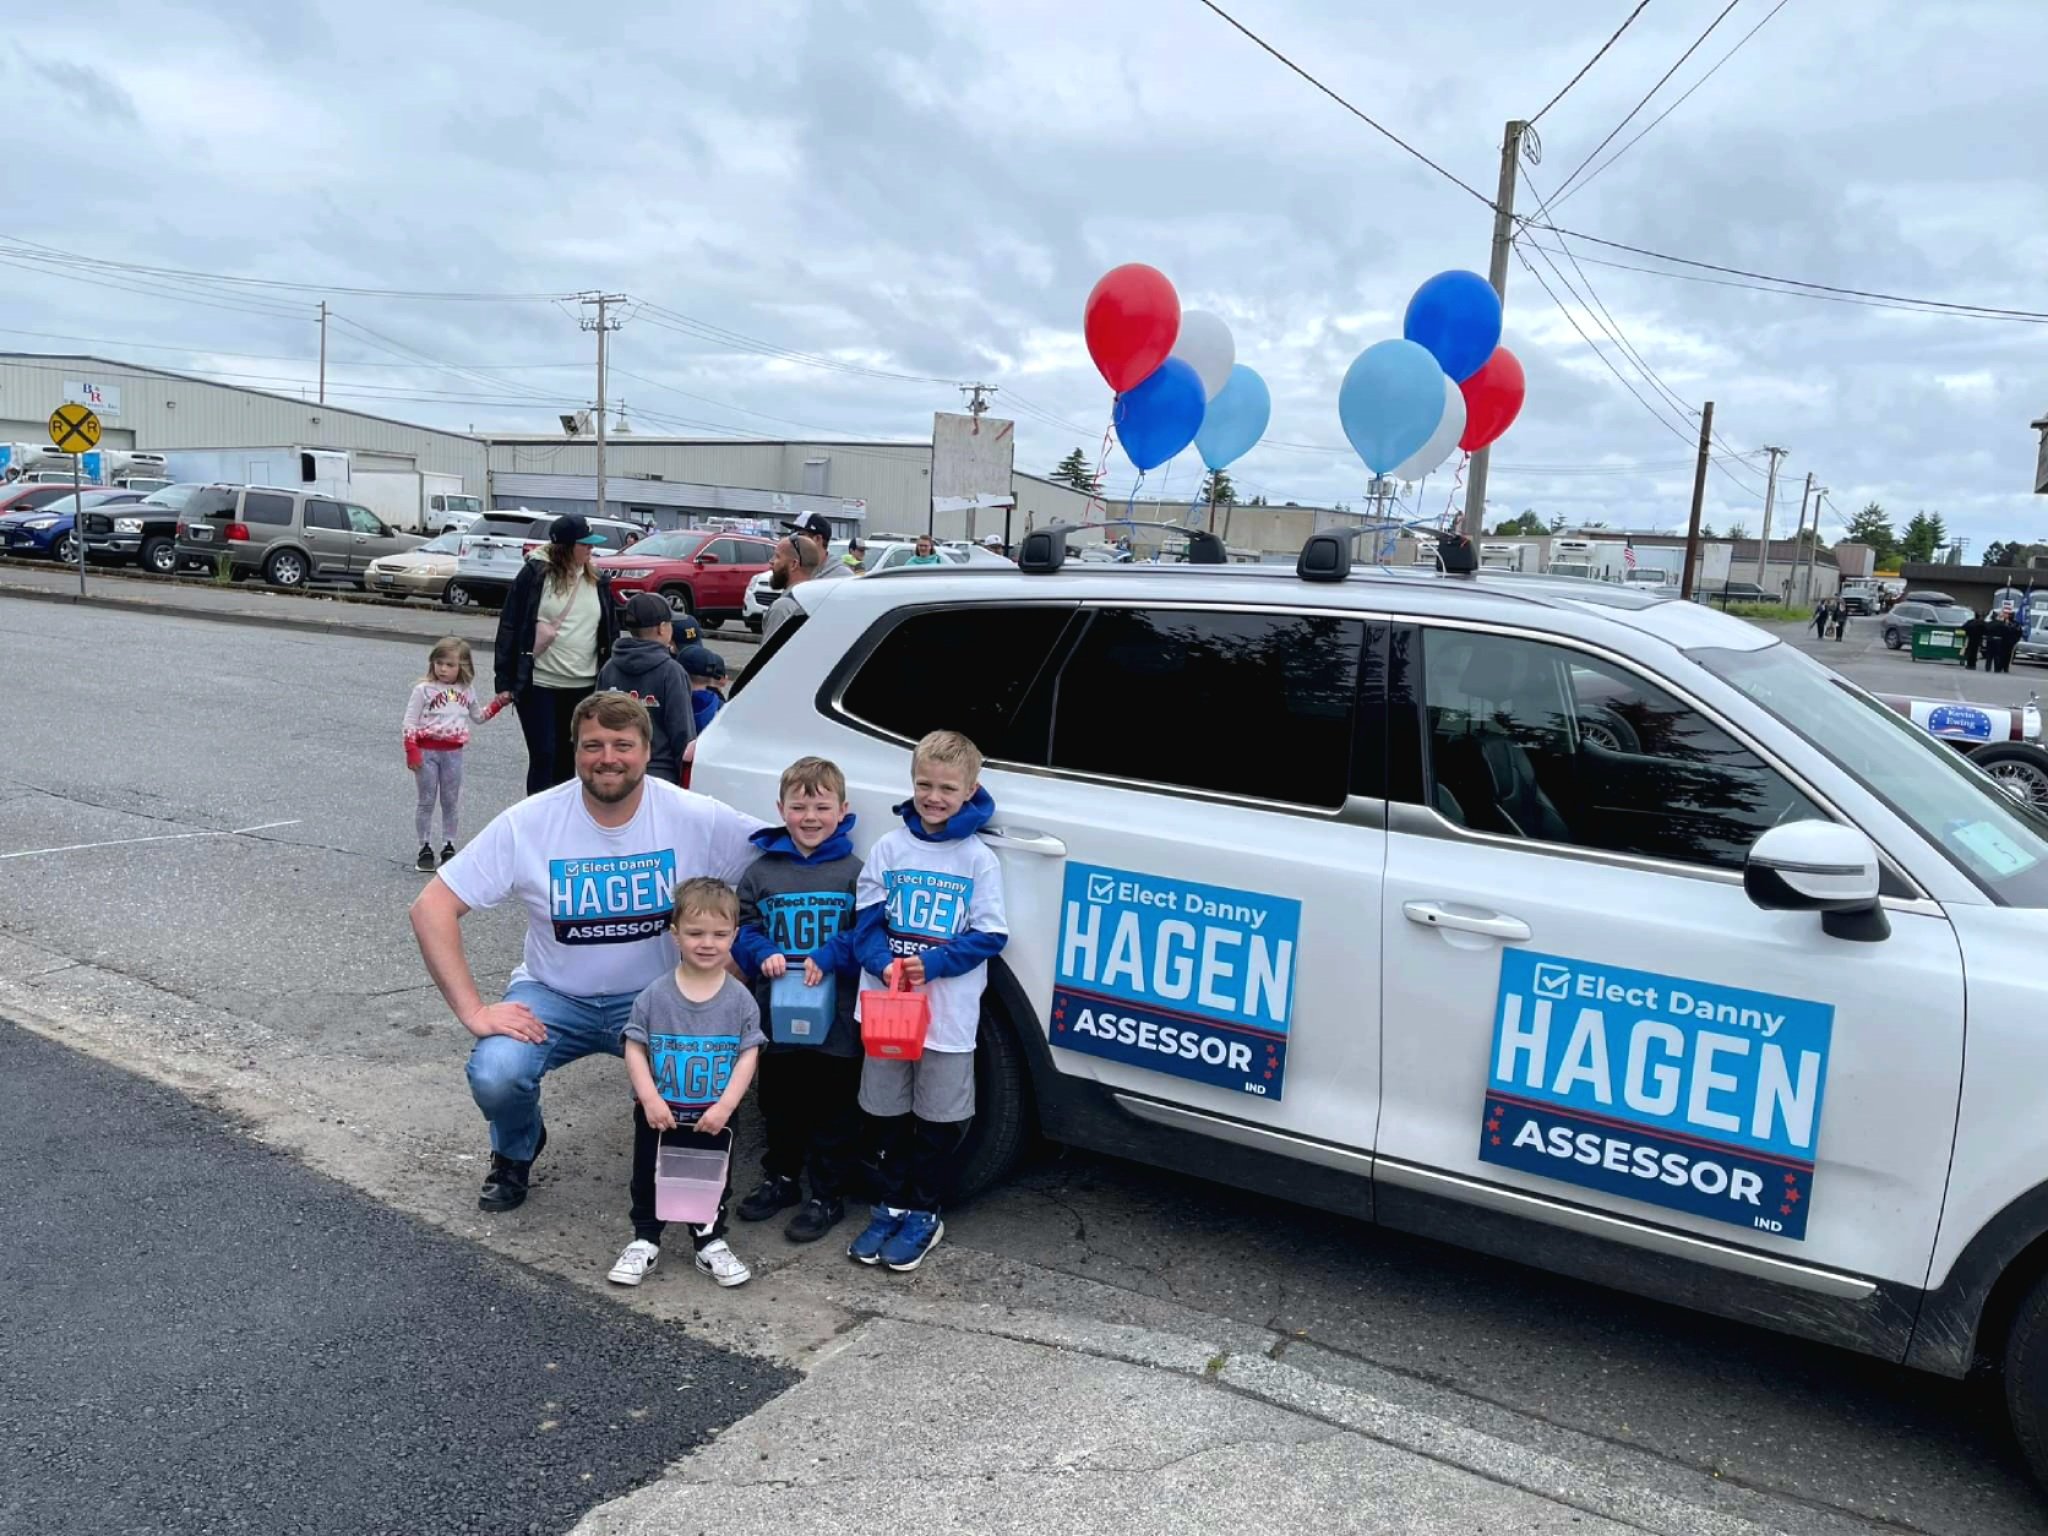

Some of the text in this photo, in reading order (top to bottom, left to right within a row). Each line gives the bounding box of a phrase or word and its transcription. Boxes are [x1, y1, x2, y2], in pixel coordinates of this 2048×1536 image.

[1946, 718, 1976, 729] Ewing
[1948, 710, 1975, 719] Kevin
[582, 858, 661, 873] Elect Danny
[927, 876, 967, 893] Danny
[552, 867, 676, 916] HAGEN
[808, 896, 847, 908] Danny
[885, 889, 970, 935] AGEN
[1118, 882, 1268, 929] Elect Danny
[766, 909, 850, 951] AGE
[1061, 901, 1292, 1023] HAGEN
[1575, 974, 1786, 1037] Elect Danny
[664, 1038, 699, 1052] Elect
[1074, 1009, 1252, 1073] ASSESSOR
[650, 1055, 740, 1098] AGE
[1245, 1082, 1266, 1095] IND
[1496, 993, 1821, 1148] HAGEN
[1512, 1120, 1764, 1206] ASSESSOR
[1754, 1216, 1782, 1232] IND
